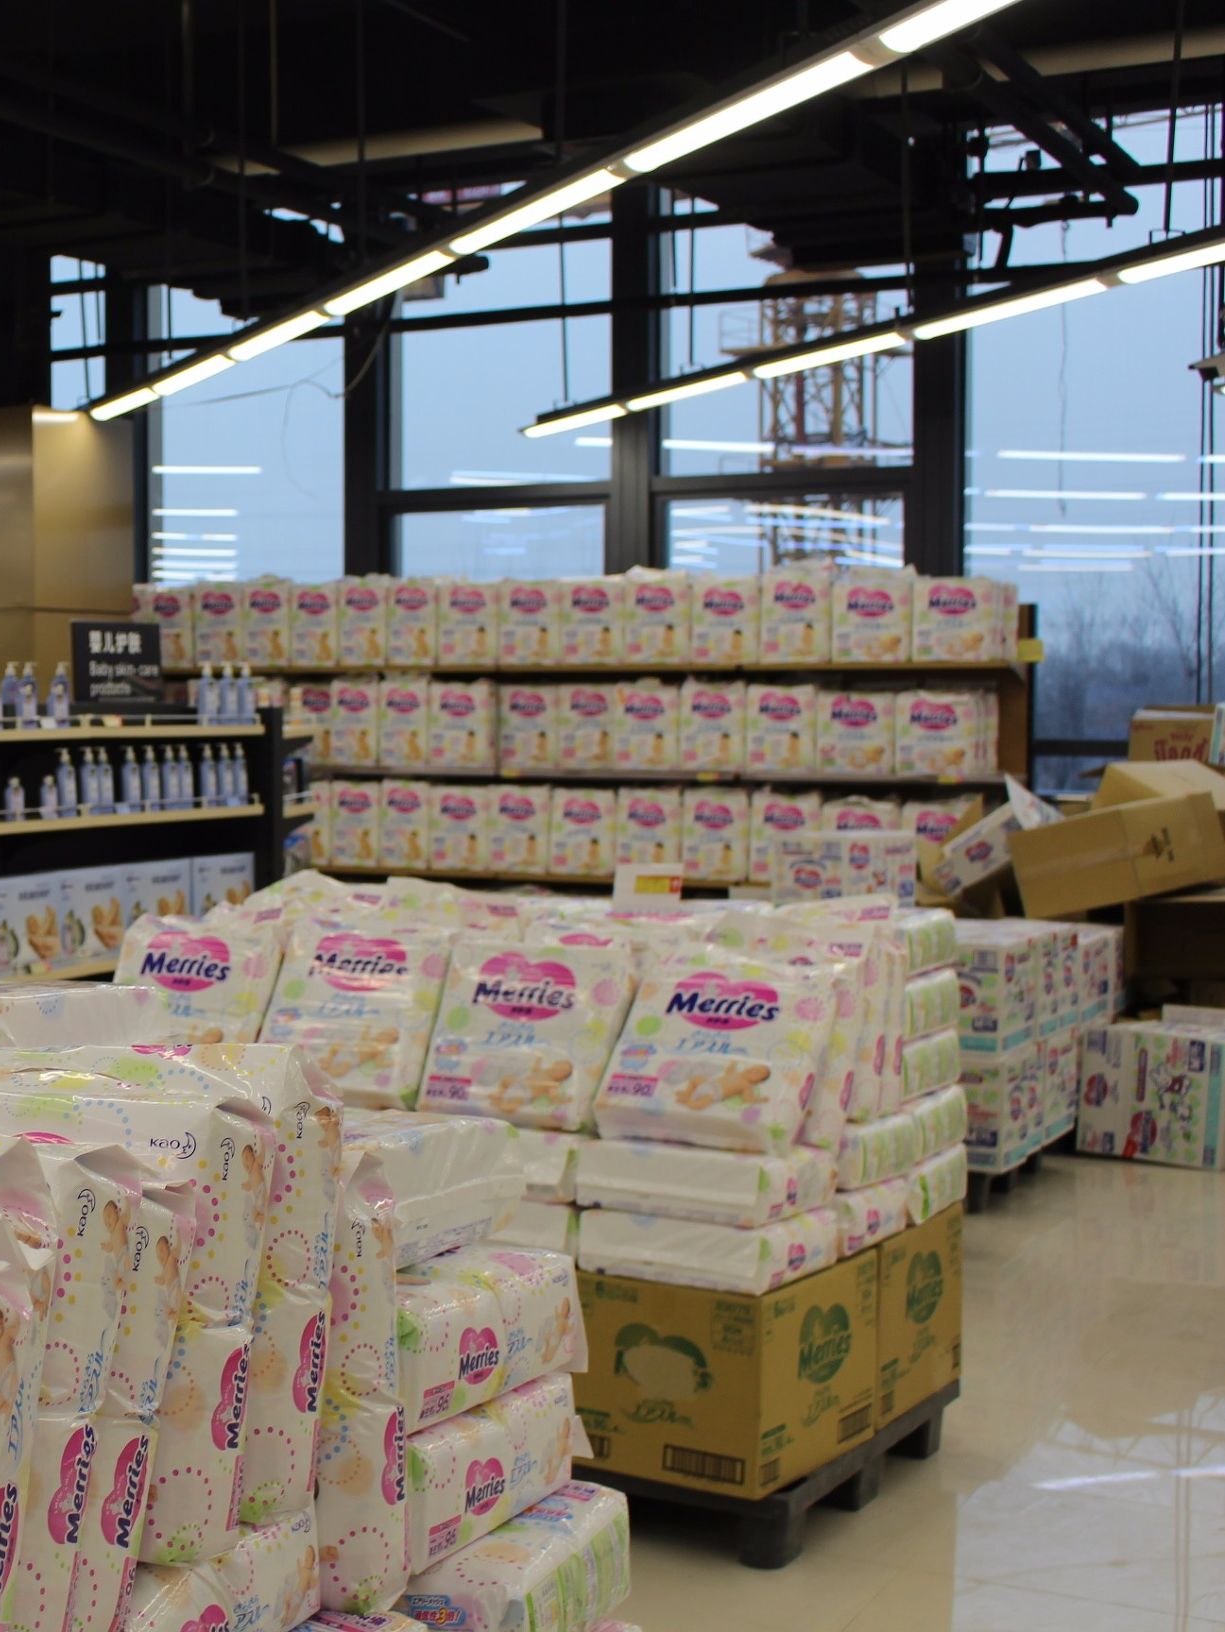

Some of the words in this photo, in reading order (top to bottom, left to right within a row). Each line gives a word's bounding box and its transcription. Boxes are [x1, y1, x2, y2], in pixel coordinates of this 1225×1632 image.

[139, 952, 230, 982] Merries
[473, 979, 576, 1011] Merries
[665, 991, 781, 1022] Merries
[150, 1137, 181, 1151] kao
[77, 1203, 89, 1237] kao
[132, 1241, 143, 1272] kao
[307, 1311, 326, 1413] Merries
[459, 1343, 500, 1380] Merries
[227, 1343, 250, 1449] Merries
[66, 1423, 97, 1544] Merries
[116, 1434, 150, 1549] Merries
[465, 1475, 506, 1513] Merries
